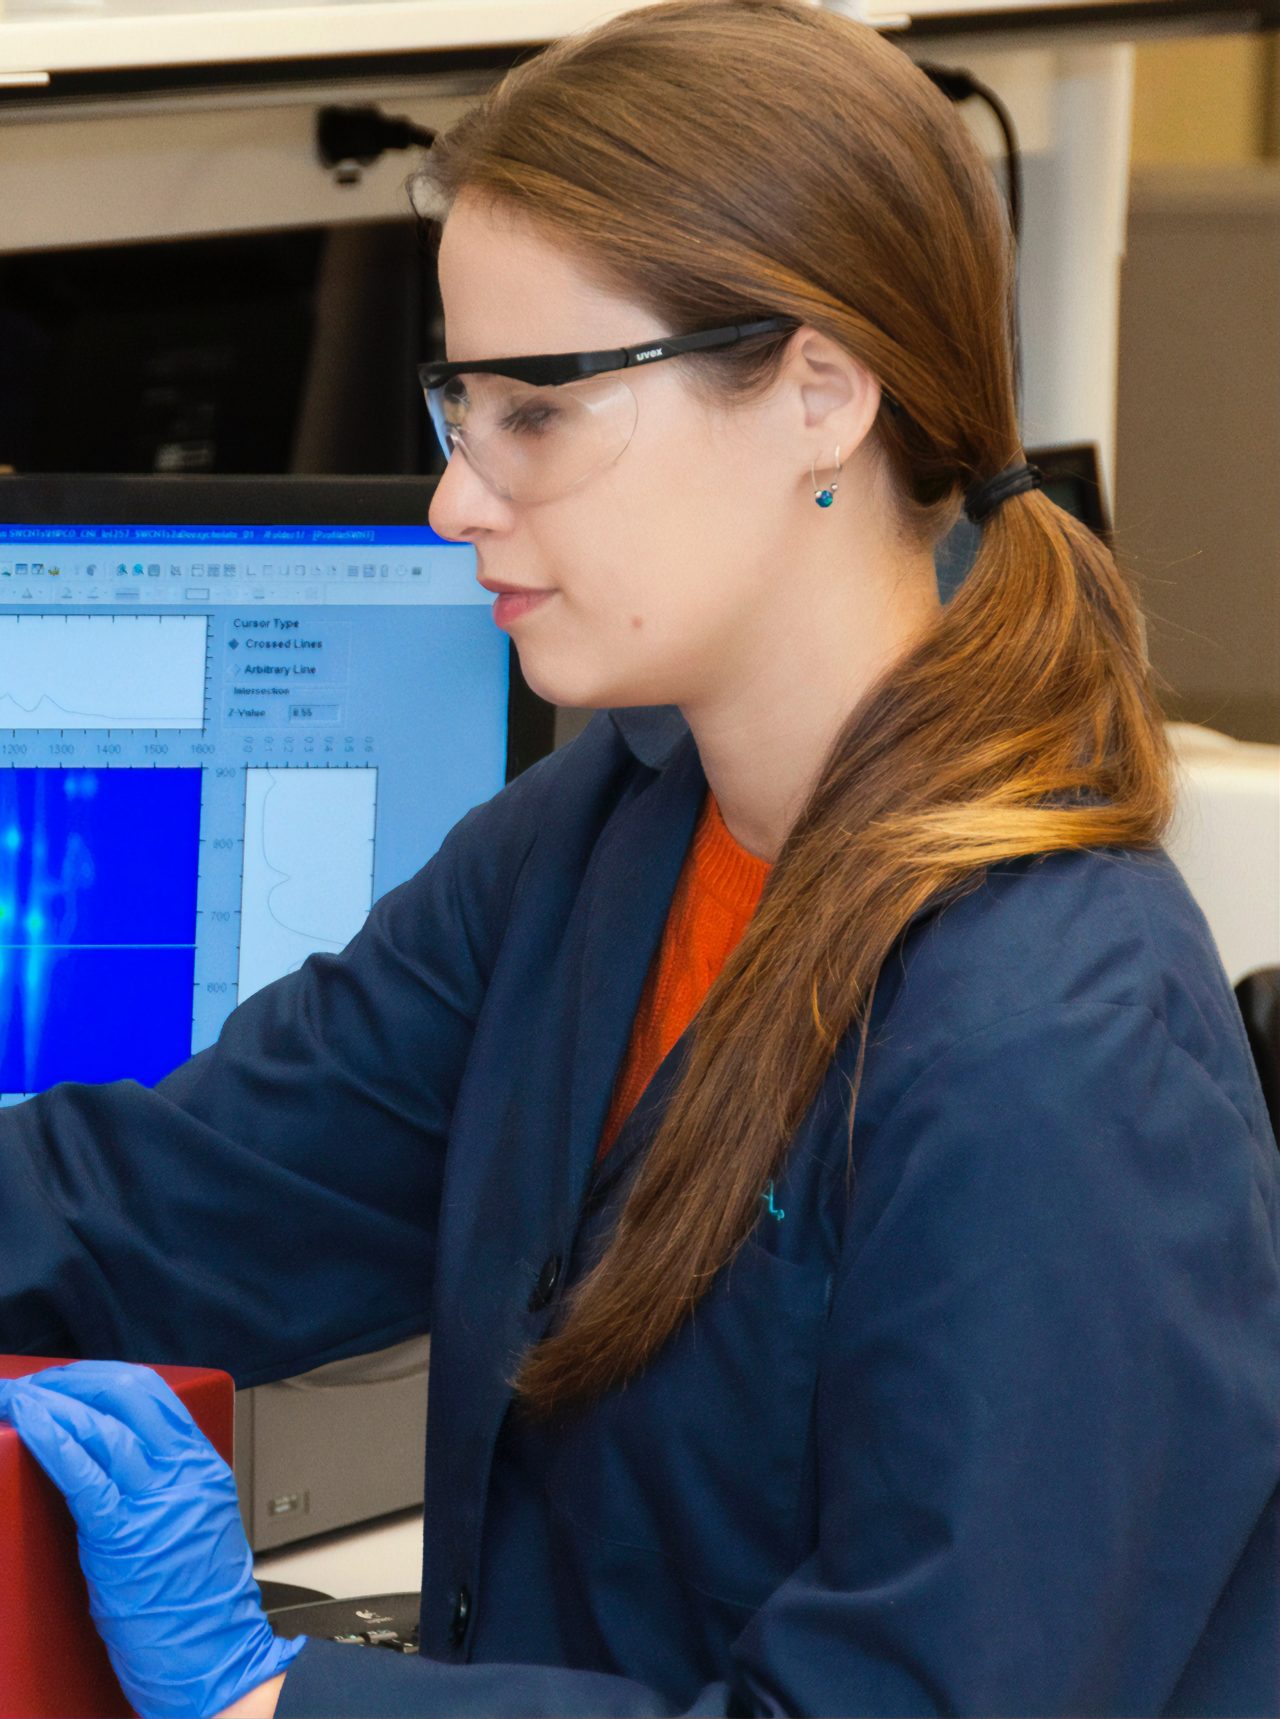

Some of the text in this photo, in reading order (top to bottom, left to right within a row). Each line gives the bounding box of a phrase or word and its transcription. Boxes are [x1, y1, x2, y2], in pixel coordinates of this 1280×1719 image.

[636, 347, 663, 361] uvex
[234, 618, 300, 630] Cursor Type
[245, 638, 323, 649] Crossed Lines
[244, 664, 317, 676] Arbitrary Line
[2, 744, 27, 754] 1200
[49, 744, 74, 754] 1300
[96, 744, 121, 754] 1400
[144, 744, 169, 754] 1500
[210, 912, 230, 922] 700
